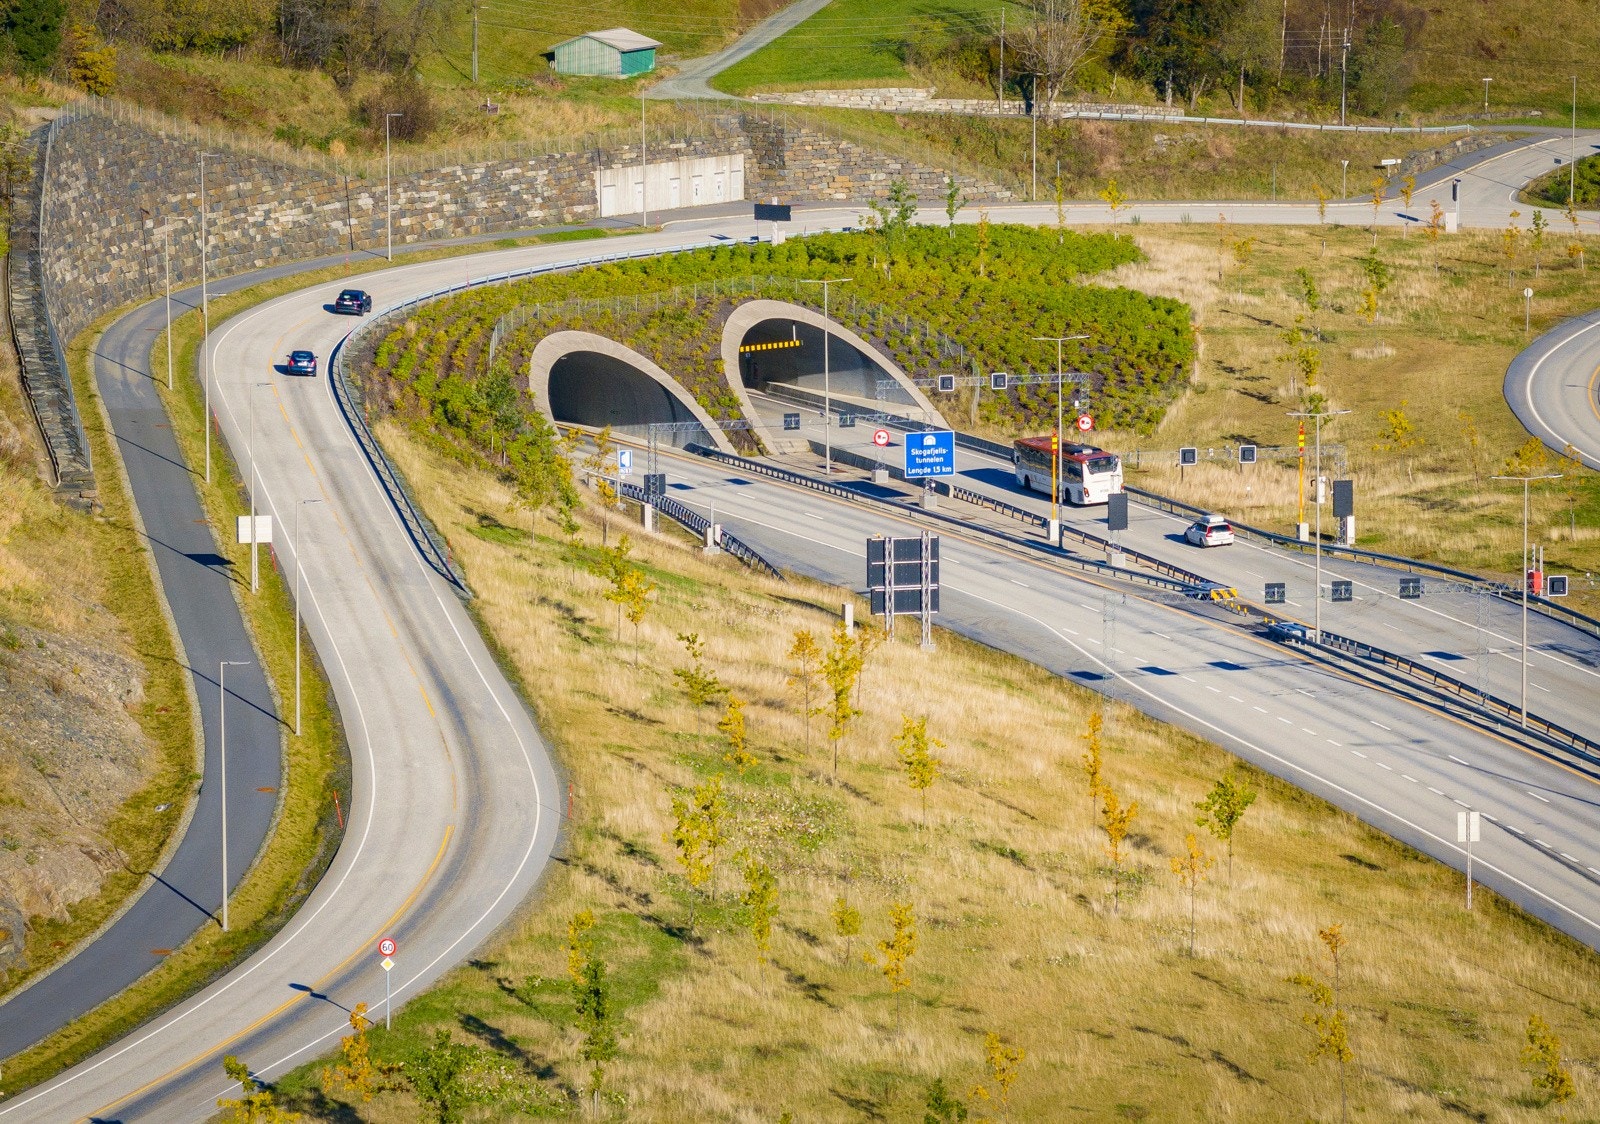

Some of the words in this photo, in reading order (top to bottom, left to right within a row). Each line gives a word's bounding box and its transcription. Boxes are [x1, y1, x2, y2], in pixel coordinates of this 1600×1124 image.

[911, 448, 948, 456] Skogafjells-
[908, 466, 931, 475] Lengde
[382, 944, 393, 952] 60
